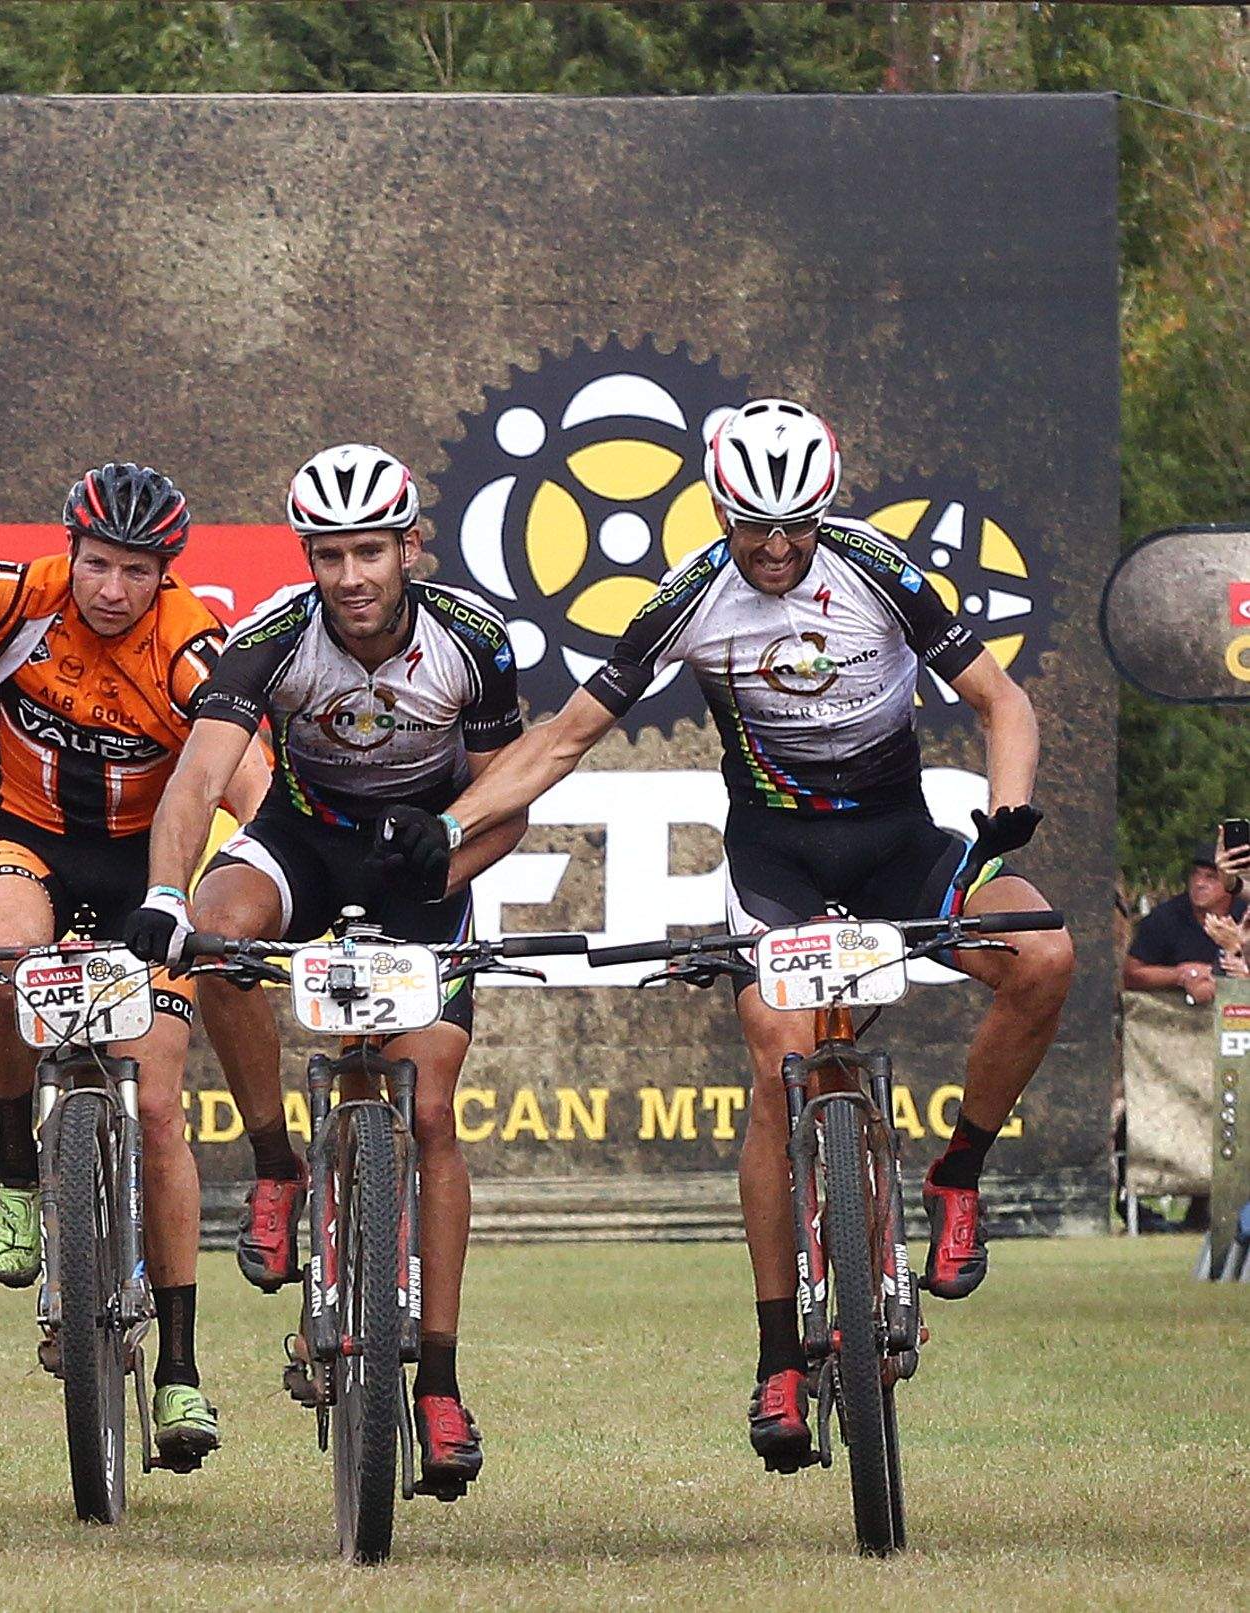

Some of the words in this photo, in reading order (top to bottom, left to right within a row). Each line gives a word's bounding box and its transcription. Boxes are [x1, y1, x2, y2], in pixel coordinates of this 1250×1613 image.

[819, 527, 904, 574] velocity
[424, 588, 506, 650] velocity
[769, 952, 833, 973] CAPE
[26, 985, 85, 1008] CAPE
[372, 974, 427, 993] EPIC
[809, 973, 860, 1002] 1-1
[155, 994, 194, 1020] GOL
[336, 998, 398, 1026] 1-2
[637, 1085, 747, 1141] MT
